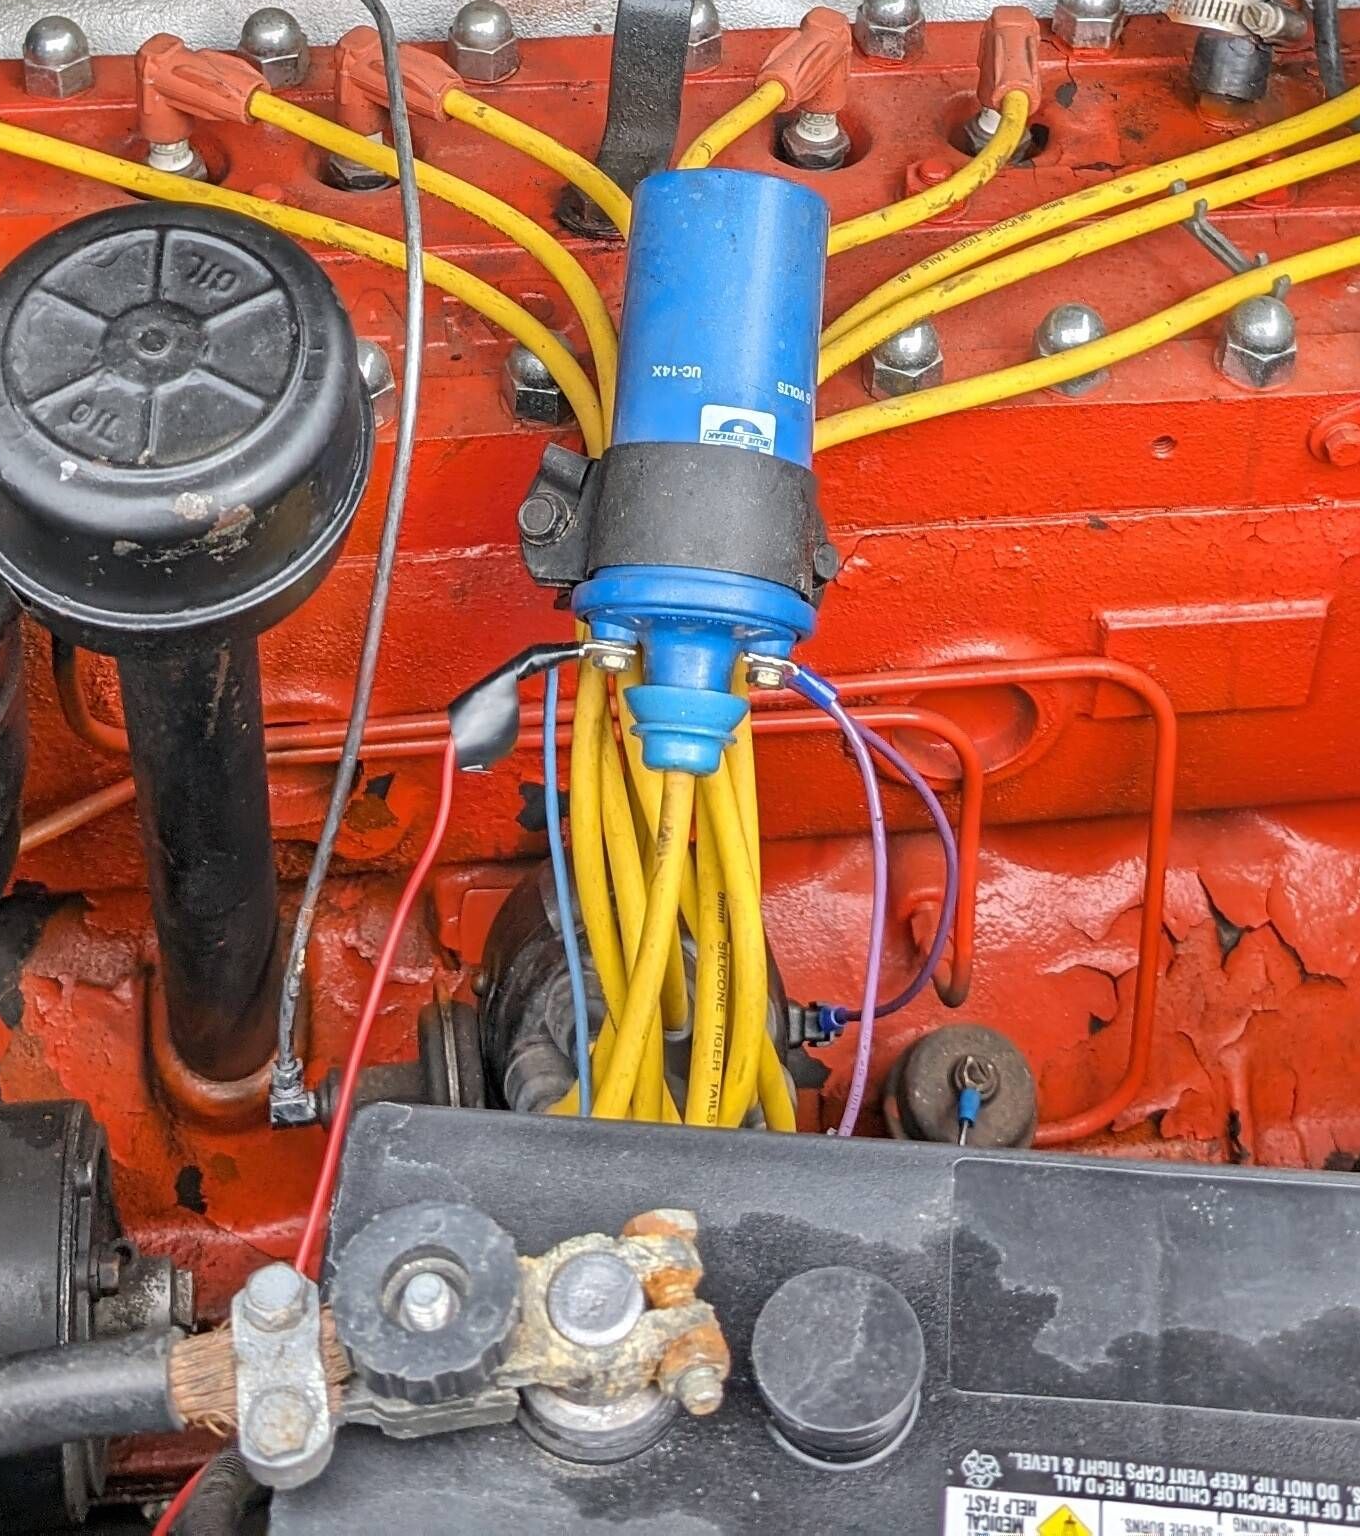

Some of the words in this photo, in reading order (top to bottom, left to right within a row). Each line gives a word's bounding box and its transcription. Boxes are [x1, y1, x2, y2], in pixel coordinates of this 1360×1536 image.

[919, 251, 949, 271] TAILS
[186, 253, 238, 293] OIL
[651, 365, 702, 379] UC-14X
[777, 381, 806, 403] VOLTS
[69, 401, 120, 448] OIL
[707, 431, 745, 446] STREAK
[749, 435, 771, 449] BLUE
[714, 940, 727, 1014] SILICONE
[712, 1023, 724, 1072] TIGER
[1008, 1452, 1061, 1473] LEVEL.
[1062, 1457, 1076, 1474] &
[1077, 1458, 1123, 1479] TIGHT
[1125, 1461, 1166, 1483] CAPS
[1053, 1474, 1083, 1492] ALL
[1084, 1475, 1127, 1497] READ
[1167, 1467, 1208, 1487] VENT
[1209, 1471, 1250, 1491] KEEP
[1252, 1475, 1280, 1495] TIP.
[1130, 1481, 1212, 1506] CHILDREN.
[1283, 1478, 1314, 1498] NOT
[1316, 1482, 1340, 1501] DO
[964, 1493, 999, 1513] FAST.
[1004, 1498, 1037, 1517] HELP
[1213, 1490, 1235, 1508] OF
[1237, 1492, 1288, 1514] REACH
[1290, 1498, 1320, 1517] THE
[1321, 1502, 1343, 1520] OF
[965, 1513, 1025, 1534] MEDICAL
